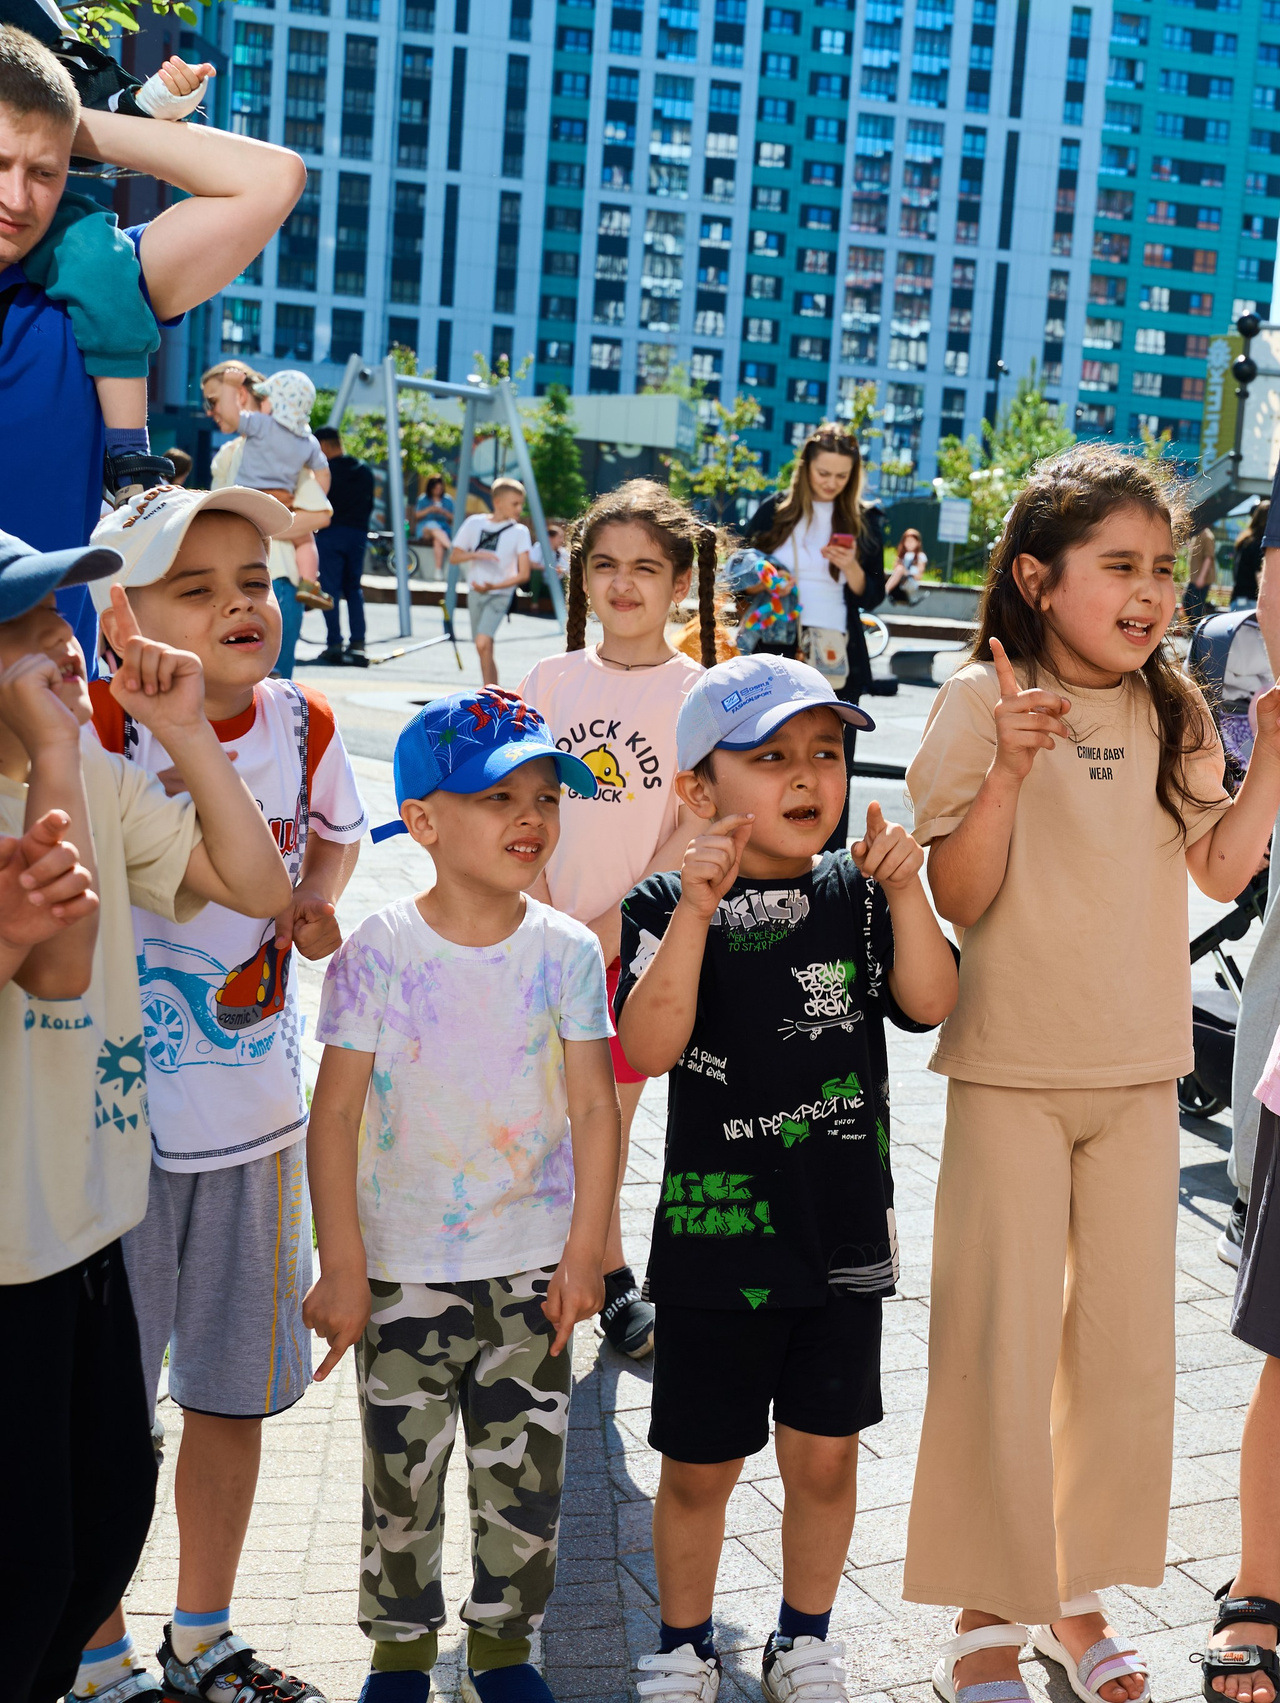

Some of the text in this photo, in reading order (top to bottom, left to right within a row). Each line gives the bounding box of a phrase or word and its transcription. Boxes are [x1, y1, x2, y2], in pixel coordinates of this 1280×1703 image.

[625, 731, 662, 789] KIDS
[1077, 745, 1125, 761] CRIMEA BABY
[1088, 766, 1113, 780] WEAR
[568, 787, 623, 803] G.UCK
[728, 941, 774, 952] TO START
[723, 1118, 754, 1141] NEW
[834, 1118, 856, 1126] ENJOY
[290, 1160, 303, 1228] SUPER
